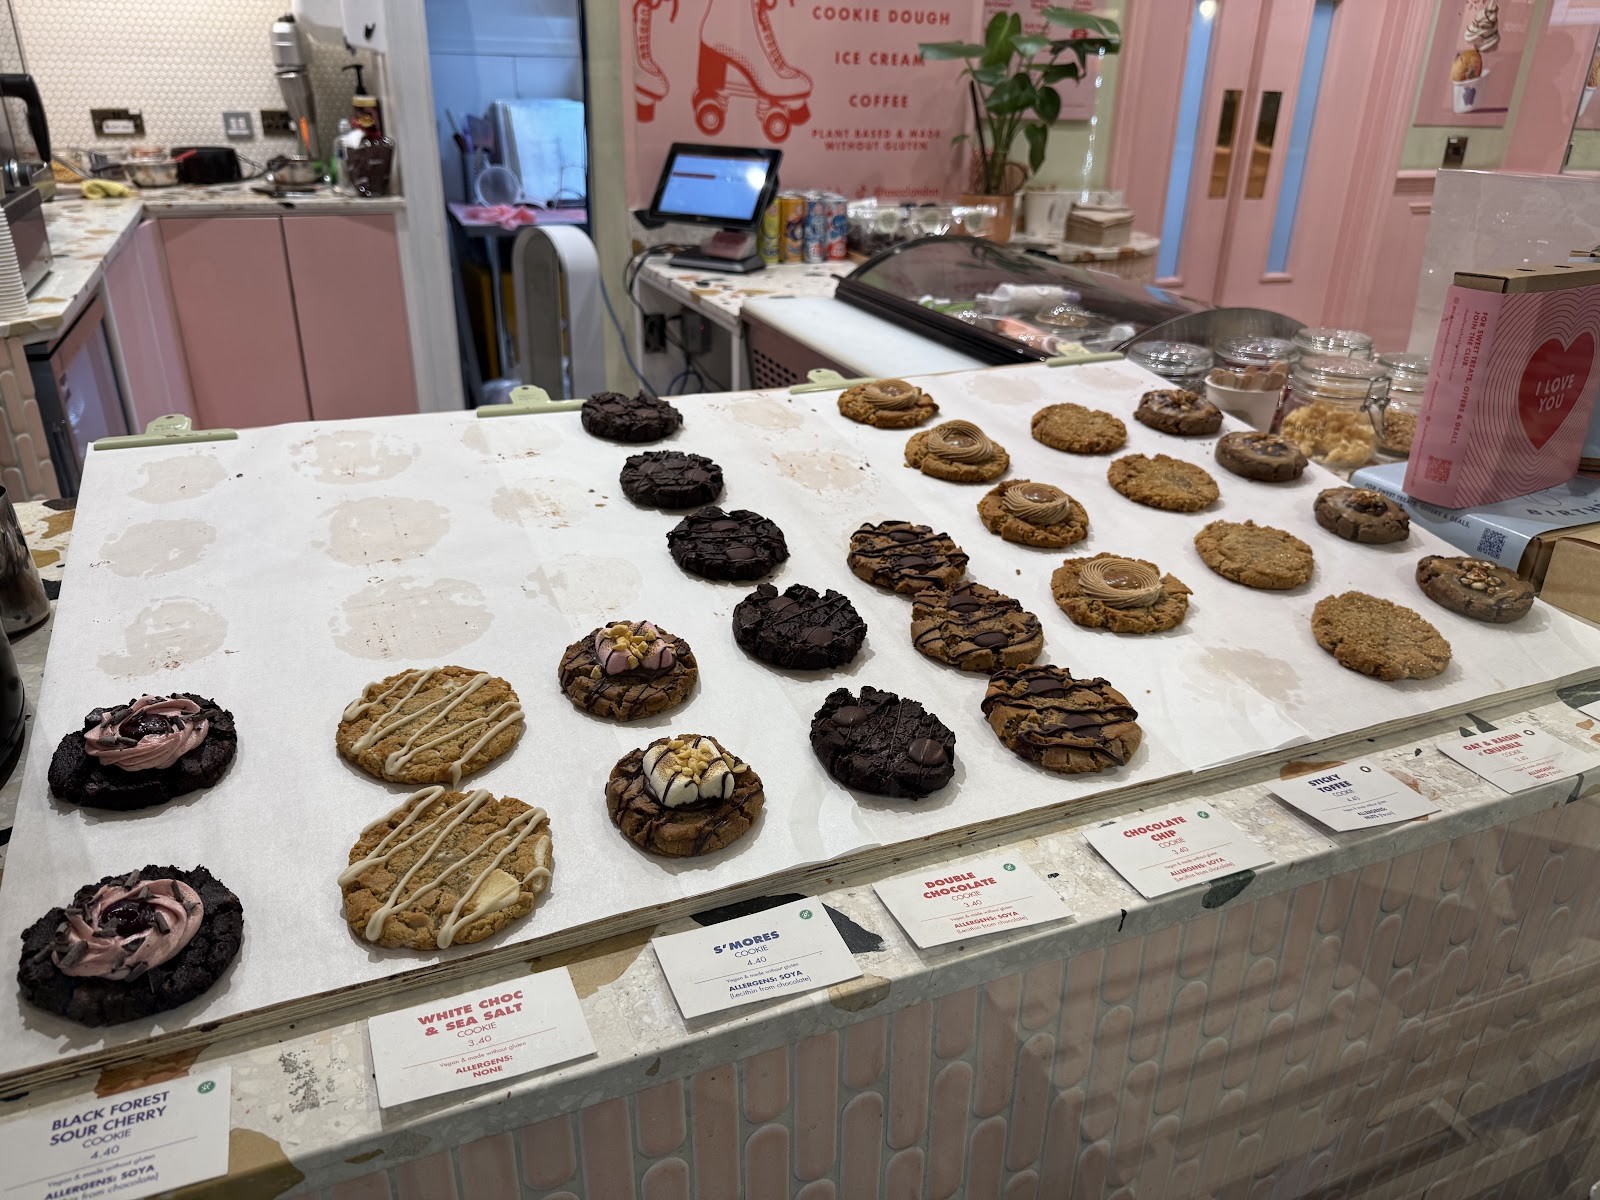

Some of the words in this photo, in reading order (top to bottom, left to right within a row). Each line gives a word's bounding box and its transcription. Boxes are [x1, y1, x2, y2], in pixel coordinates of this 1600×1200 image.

[812, 6, 880, 22] COOKIE
[888, 9, 951, 25] DOUGH
[834, 51, 861, 65] ICE
[869, 52, 926, 67] CREAM
[848, 94, 909, 109] COFFEE
[811, 128, 849, 139] PLANT
[825, 141, 880, 151] WITHOUT
[1471, 310, 1480, 330] JOIN
[1478, 312, 1489, 332] FOR
[1467, 332, 1476, 346] THE
[1473, 330, 1485, 355] SWEET
[1535, 381, 1541, 397] I
[1544, 373, 1576, 395] LOVE
[1538, 393, 1565, 413] YOU
[1364, 482, 1376, 491] FOR
[1378, 487, 1396, 498] SWEET
[1490, 733, 1522, 744] RAISIN
[1483, 742, 1523, 754] CRUMBLE
[1307, 774, 1340, 786] STICKY
[1316, 781, 1352, 792] TOFFEE
[1123, 816, 1187, 837] CHOCOLATE
[1150, 830, 1176, 841] CHIP
[1158, 837, 1185, 848] COOKIE
[1170, 865, 1207, 876] ALLERGENS:
[1205, 858, 1226, 866] SOYA
[922, 878, 997, 899] CHOCOLATE
[924, 872, 976, 889] DOUBLE
[951, 891, 982, 901] COOKIE
[954, 916, 996, 928] ALLERGENS:
[713, 931, 780, 954] S'MORES
[734, 945, 769, 957] COOKIE
[747, 956, 767, 966] 4.40
[729, 977, 778, 992] ALLERGENS:
[778, 970, 803, 980] SOYA
[775, 975, 812, 988] chocolate)
[417, 1004, 473, 1025] WHITE
[478, 991, 524, 1009] CHOC
[424, 1027, 439, 1036] &
[445, 1017, 478, 1031] SEA
[483, 1003, 522, 1021] SALT
[456, 1022, 497, 1038] COOKIE
[467, 1035, 492, 1047] 3.40
[439, 1060, 460, 1068] Vegan
[485, 1047, 508, 1056] without
[455, 1055, 513, 1074] ALLERGENS:
[472, 1065, 503, 1078] NONE
[50, 1108, 106, 1131] BLACK
[109, 1091, 170, 1115] FOREST
[48, 1125, 98, 1146] SOUR
[102, 1105, 167, 1131] CHERRY
[81, 1128, 132, 1148] COOKIE
[89, 1145, 120, 1159] 4.40
[44, 1175, 117, 1200] ALLERGENS:
[119, 1164, 155, 1180] SOYA
